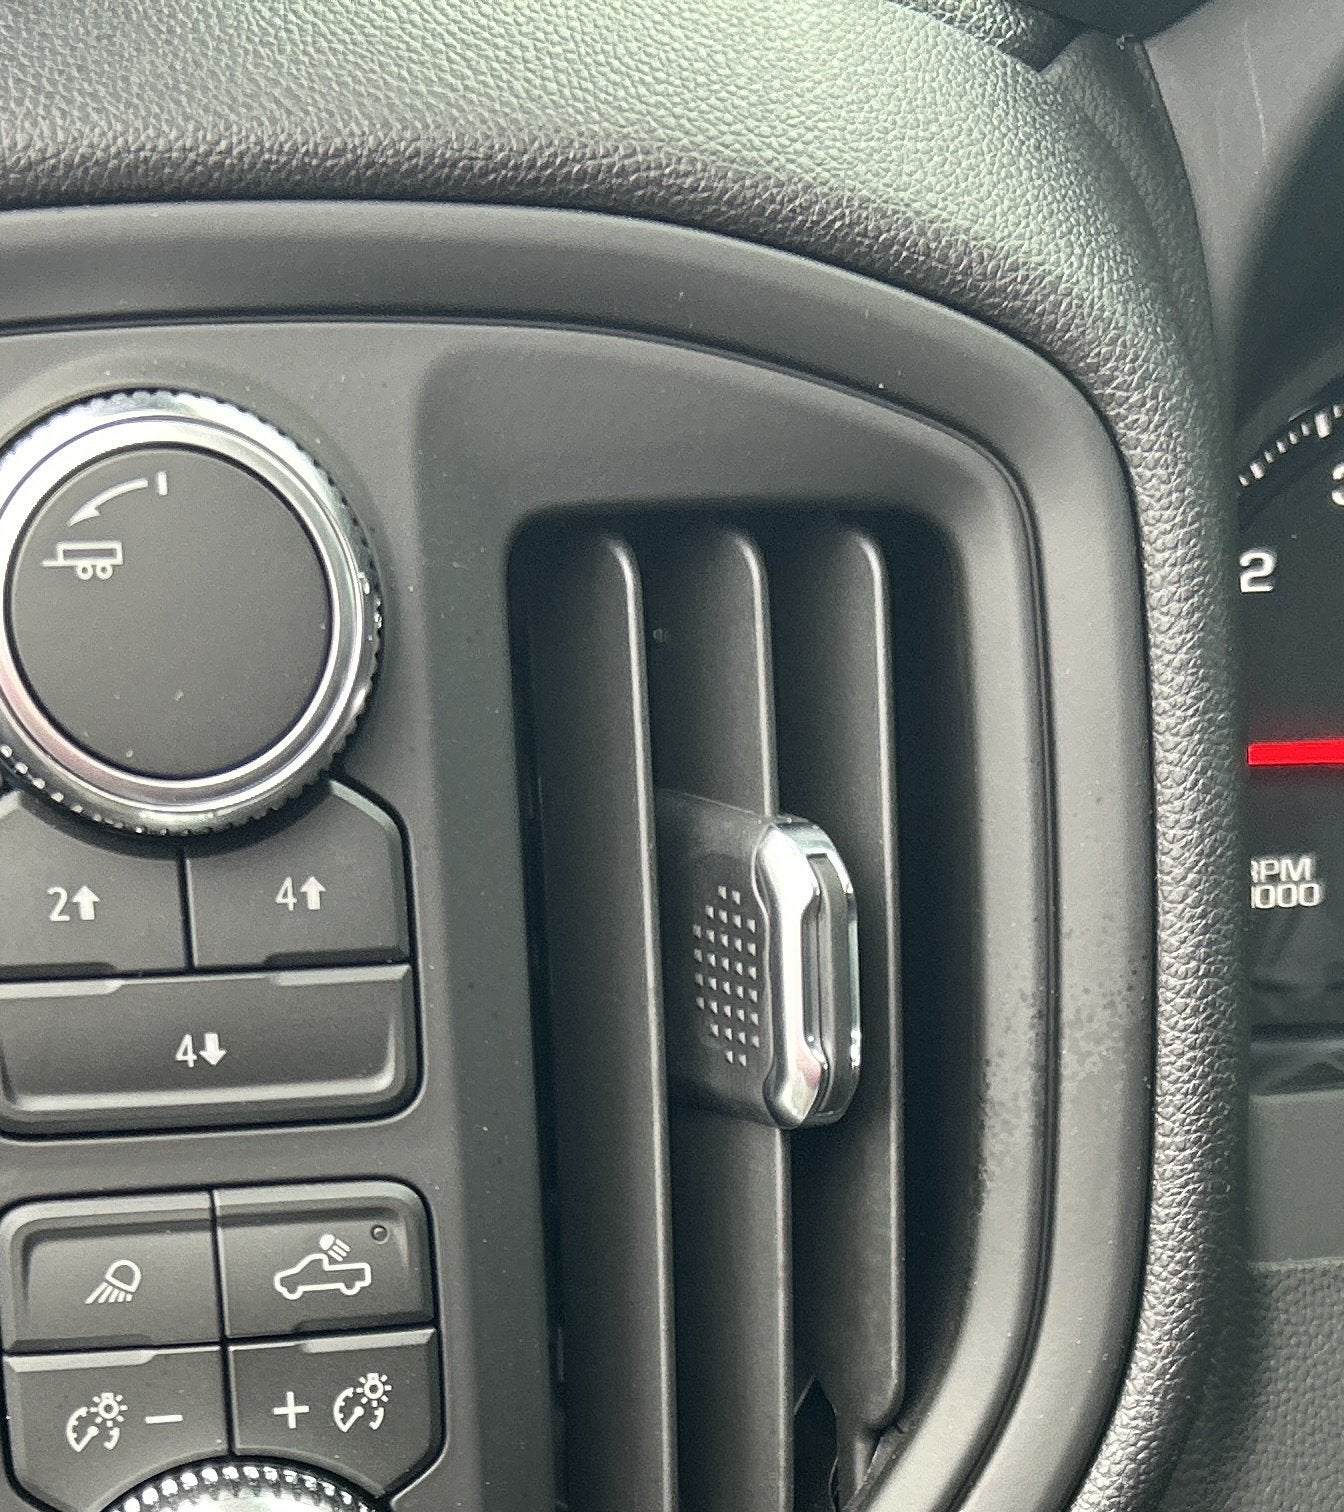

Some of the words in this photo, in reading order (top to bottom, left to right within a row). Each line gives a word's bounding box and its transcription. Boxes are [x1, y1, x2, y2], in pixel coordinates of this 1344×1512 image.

[1239, 549, 1276, 593] 2
[47, 886, 71, 922] 2
[275, 876, 297, 911] 4
[175, 1033, 198, 1068] 4
